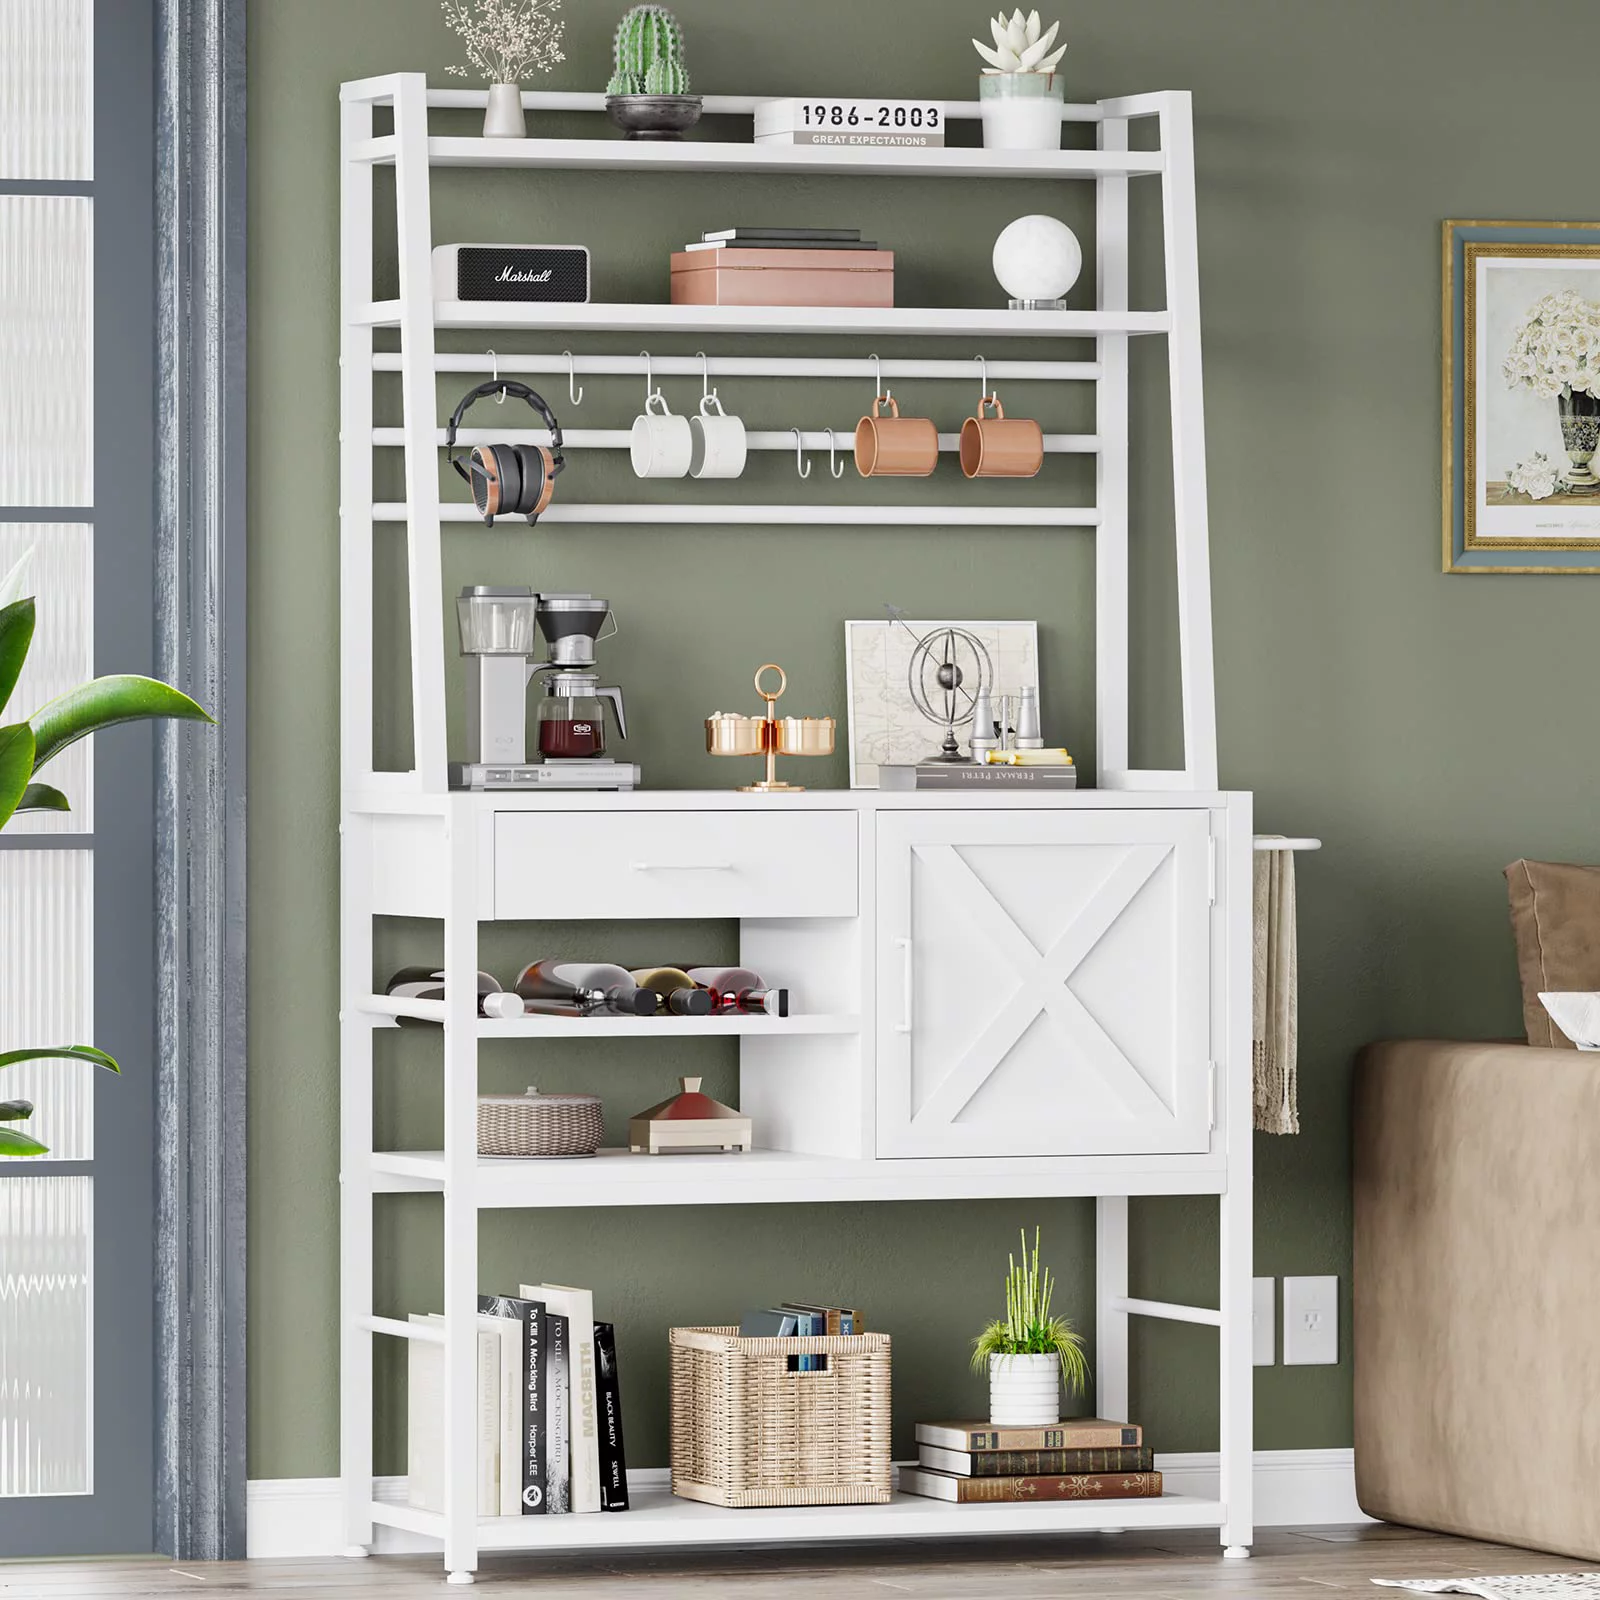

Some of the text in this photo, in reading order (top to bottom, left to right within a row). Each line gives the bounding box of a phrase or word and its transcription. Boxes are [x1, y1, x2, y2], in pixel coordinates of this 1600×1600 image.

[803, 105, 939, 128] 1986-2003
[812, 135, 927, 146] GREAT EXPECTATIONS
[494, 265, 552, 283] Marshall
[528, 1308, 538, 1412] To Kill A Mocking Bird
[554, 1319, 562, 1464] TO KILL A MOCKINGBIRD
[579, 1342, 594, 1438] MACBETH
[605, 1391, 617, 1447] BLACK BEAUTY
[528, 1424, 538, 1476] Harper LEE
[611, 1460, 620, 1489] SEWELL
